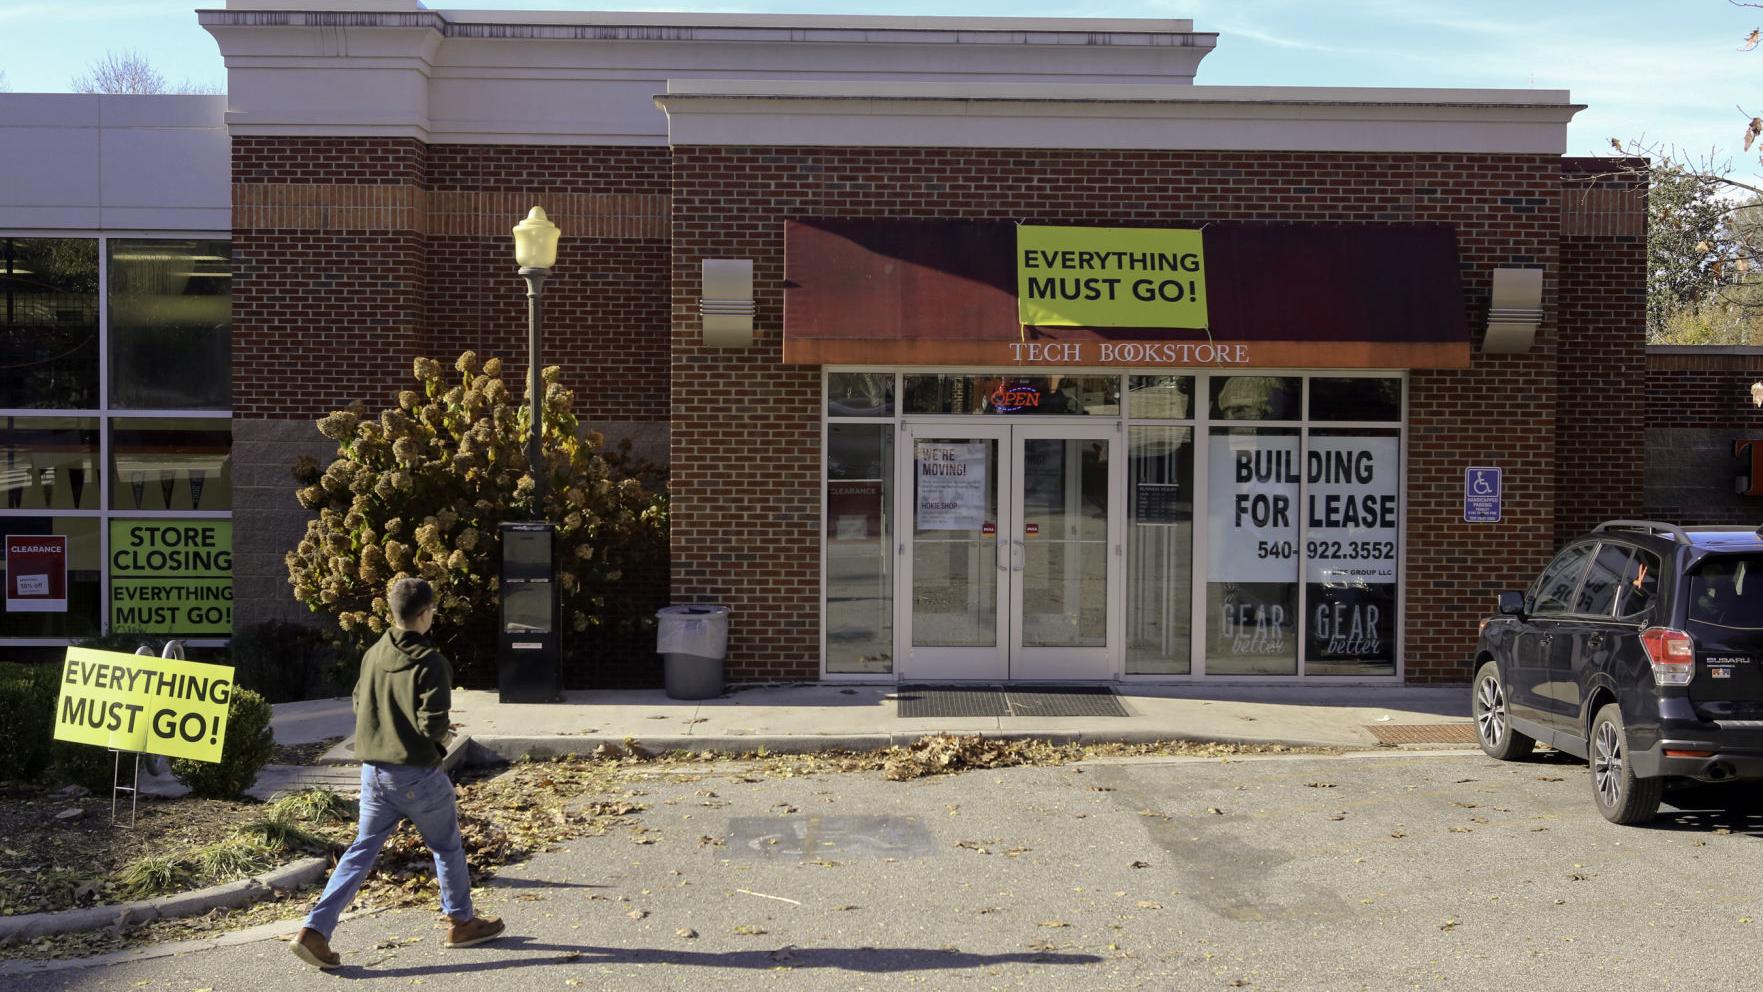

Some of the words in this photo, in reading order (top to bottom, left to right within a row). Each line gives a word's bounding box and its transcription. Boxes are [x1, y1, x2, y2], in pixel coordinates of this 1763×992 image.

[1024, 250, 1200, 272] EVERYTHING
[1028, 277, 1121, 300] MUST
[1132, 279, 1196, 302] GO!
[1009, 343, 1081, 361] TECH
[1100, 343, 1249, 363] BOOKSTORE
[991, 391, 1040, 407] OPEN
[922, 463, 966, 476] MOVING!
[1235, 449, 1373, 484] BUILDING
[830, 487, 876, 495] CLEARANCE
[1235, 494, 1289, 528] FOR
[1309, 494, 1396, 528] LEASE
[129, 526, 216, 547] STORE
[11, 545, 62, 553] CLEARANCE
[113, 550, 233, 571] CLOSING
[114, 586, 233, 601] EVERYTHING
[116, 607, 179, 624] MUST
[187, 607, 231, 624] GO!
[1222, 603, 1284, 639] GEAR
[1317, 603, 1379, 639] GEAR
[1327, 633, 1382, 654] better
[65, 660, 230, 704] EVERYTHING
[61, 696, 143, 733] MUST
[152, 708, 220, 745] GO!
